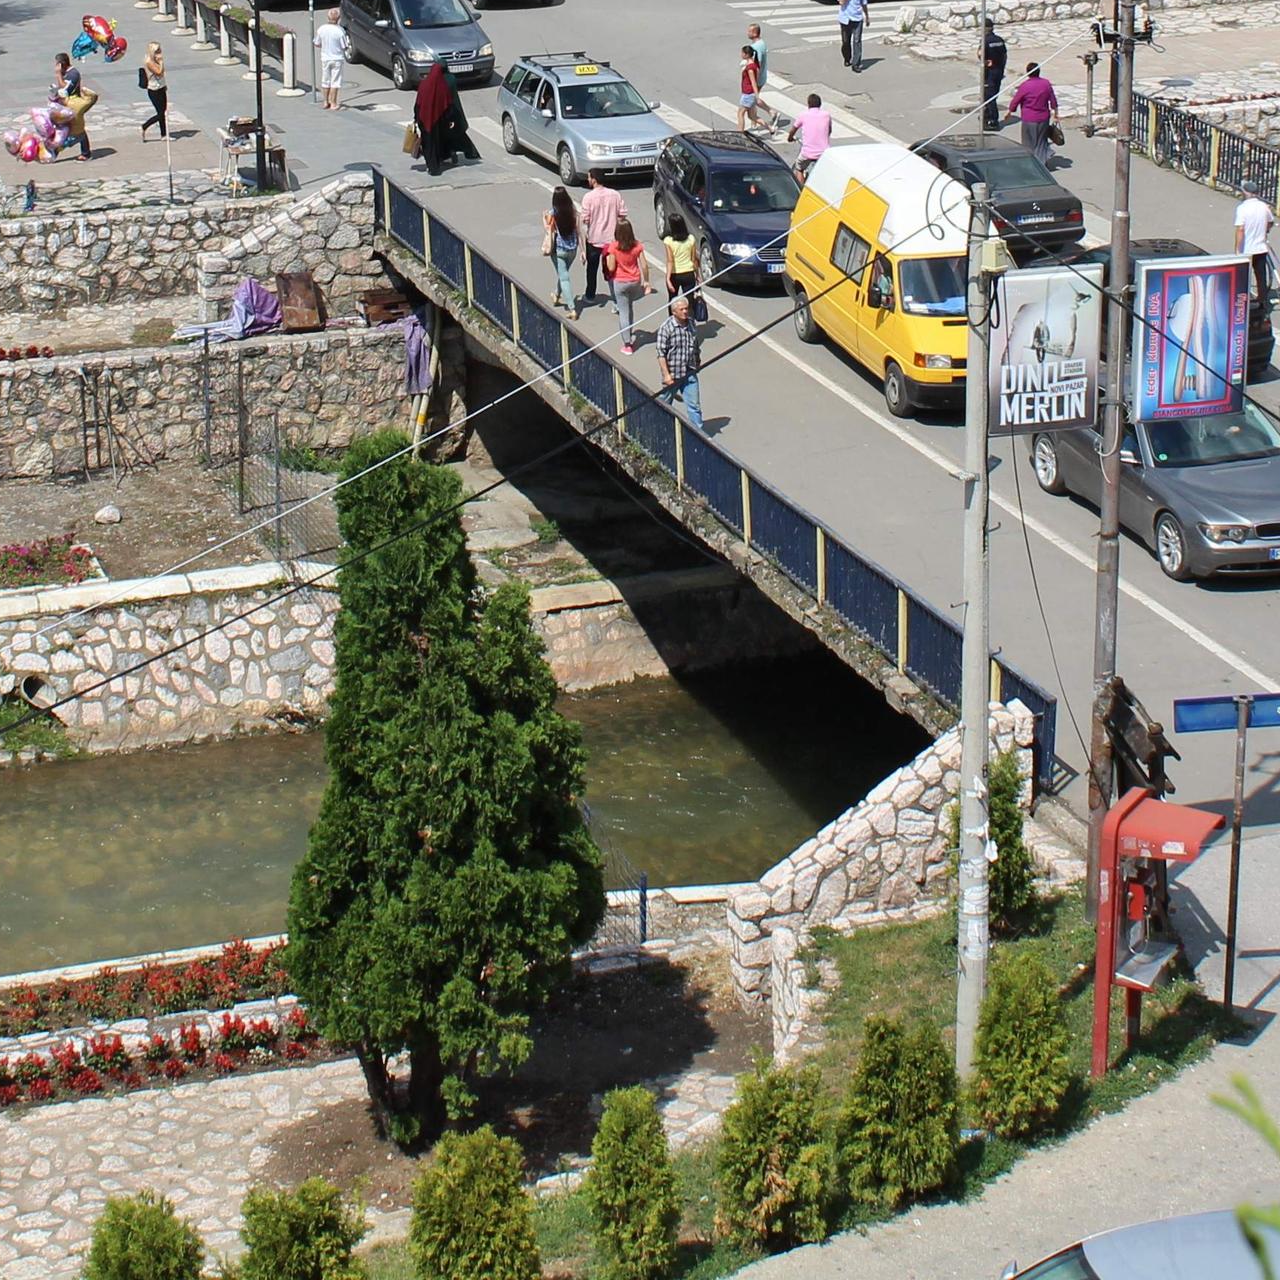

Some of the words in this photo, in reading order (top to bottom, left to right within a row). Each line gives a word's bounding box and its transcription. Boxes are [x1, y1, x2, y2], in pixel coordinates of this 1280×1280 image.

[1000, 360, 1059, 395] DINO
[1050, 383, 1066, 393] NOVI
[1065, 380, 1085, 391] PAZAR
[999, 391, 1087, 426] MERLIN
